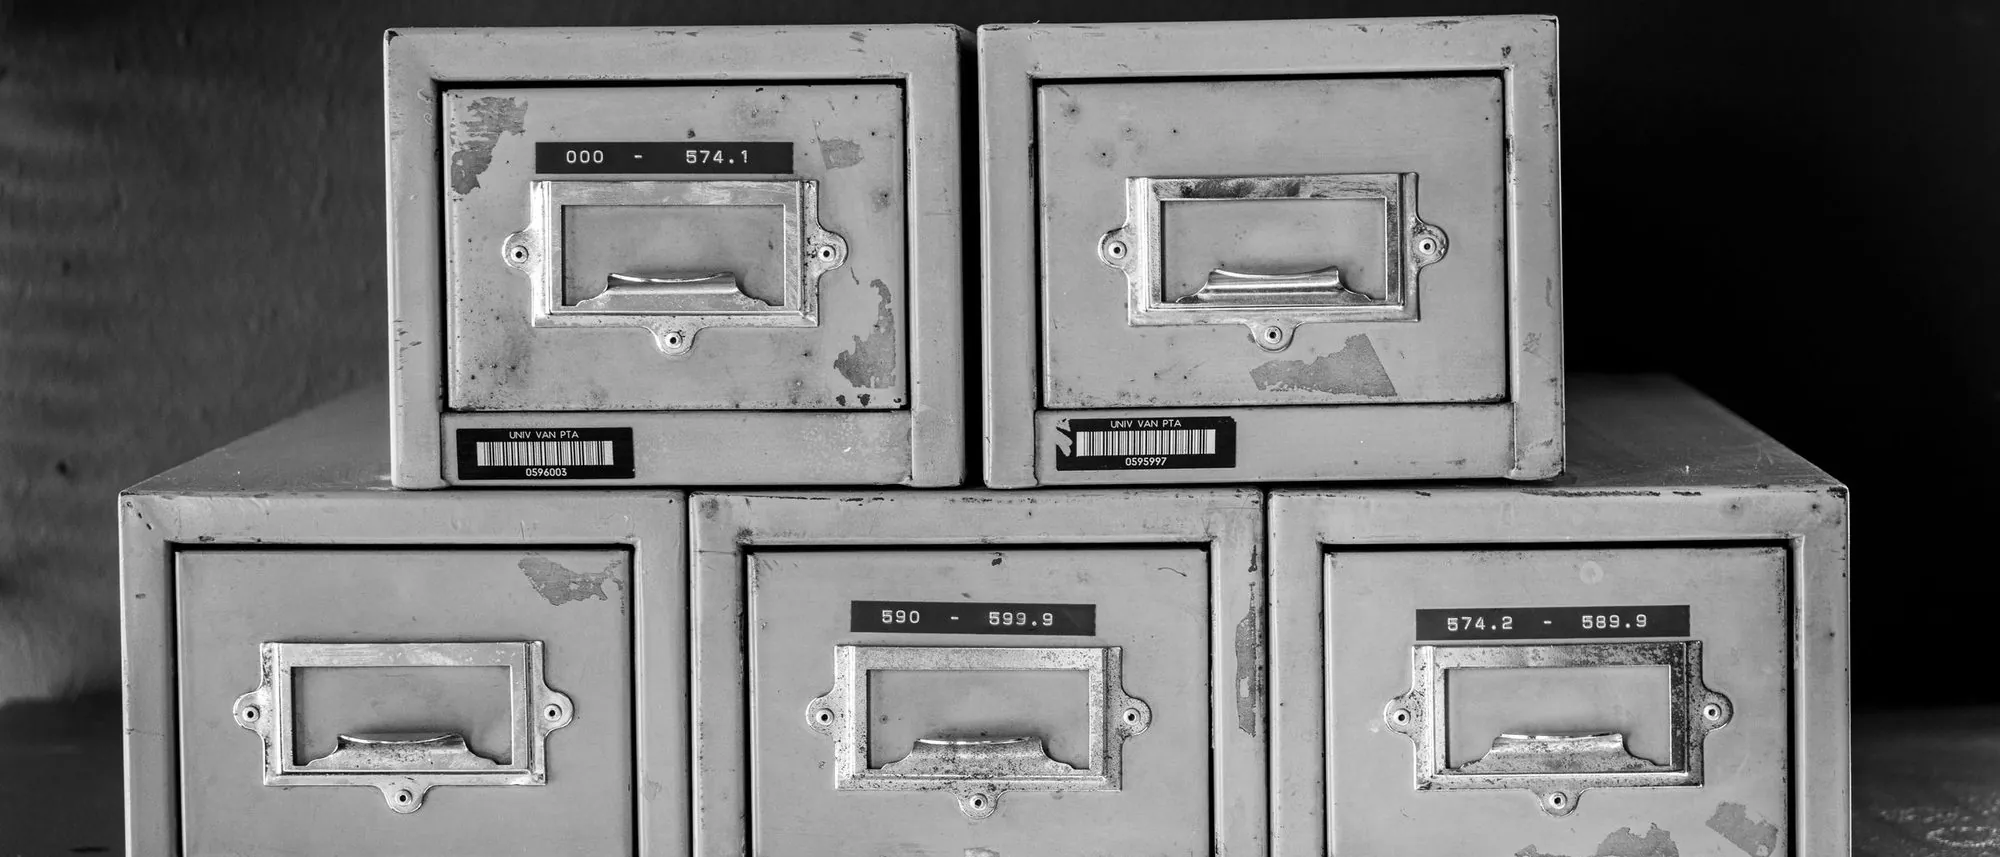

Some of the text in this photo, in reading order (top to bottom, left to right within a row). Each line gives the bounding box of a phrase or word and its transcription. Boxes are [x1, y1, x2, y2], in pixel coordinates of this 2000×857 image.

[566, 149, 604, 164] 000
[685, 149, 748, 164] 574.1
[1110, 419, 1182, 429] UNIV VAN PTA
[509, 430, 579, 440] UNIV VAN PTA
[1125, 457, 1167, 467] 0595997
[525, 467, 568, 477] 0596003
[881, 609, 920, 624] 590
[988, 611, 1054, 627] 599.9
[1447, 616, 1514, 632] 574.2
[1581, 613, 1648, 630] 589.9
